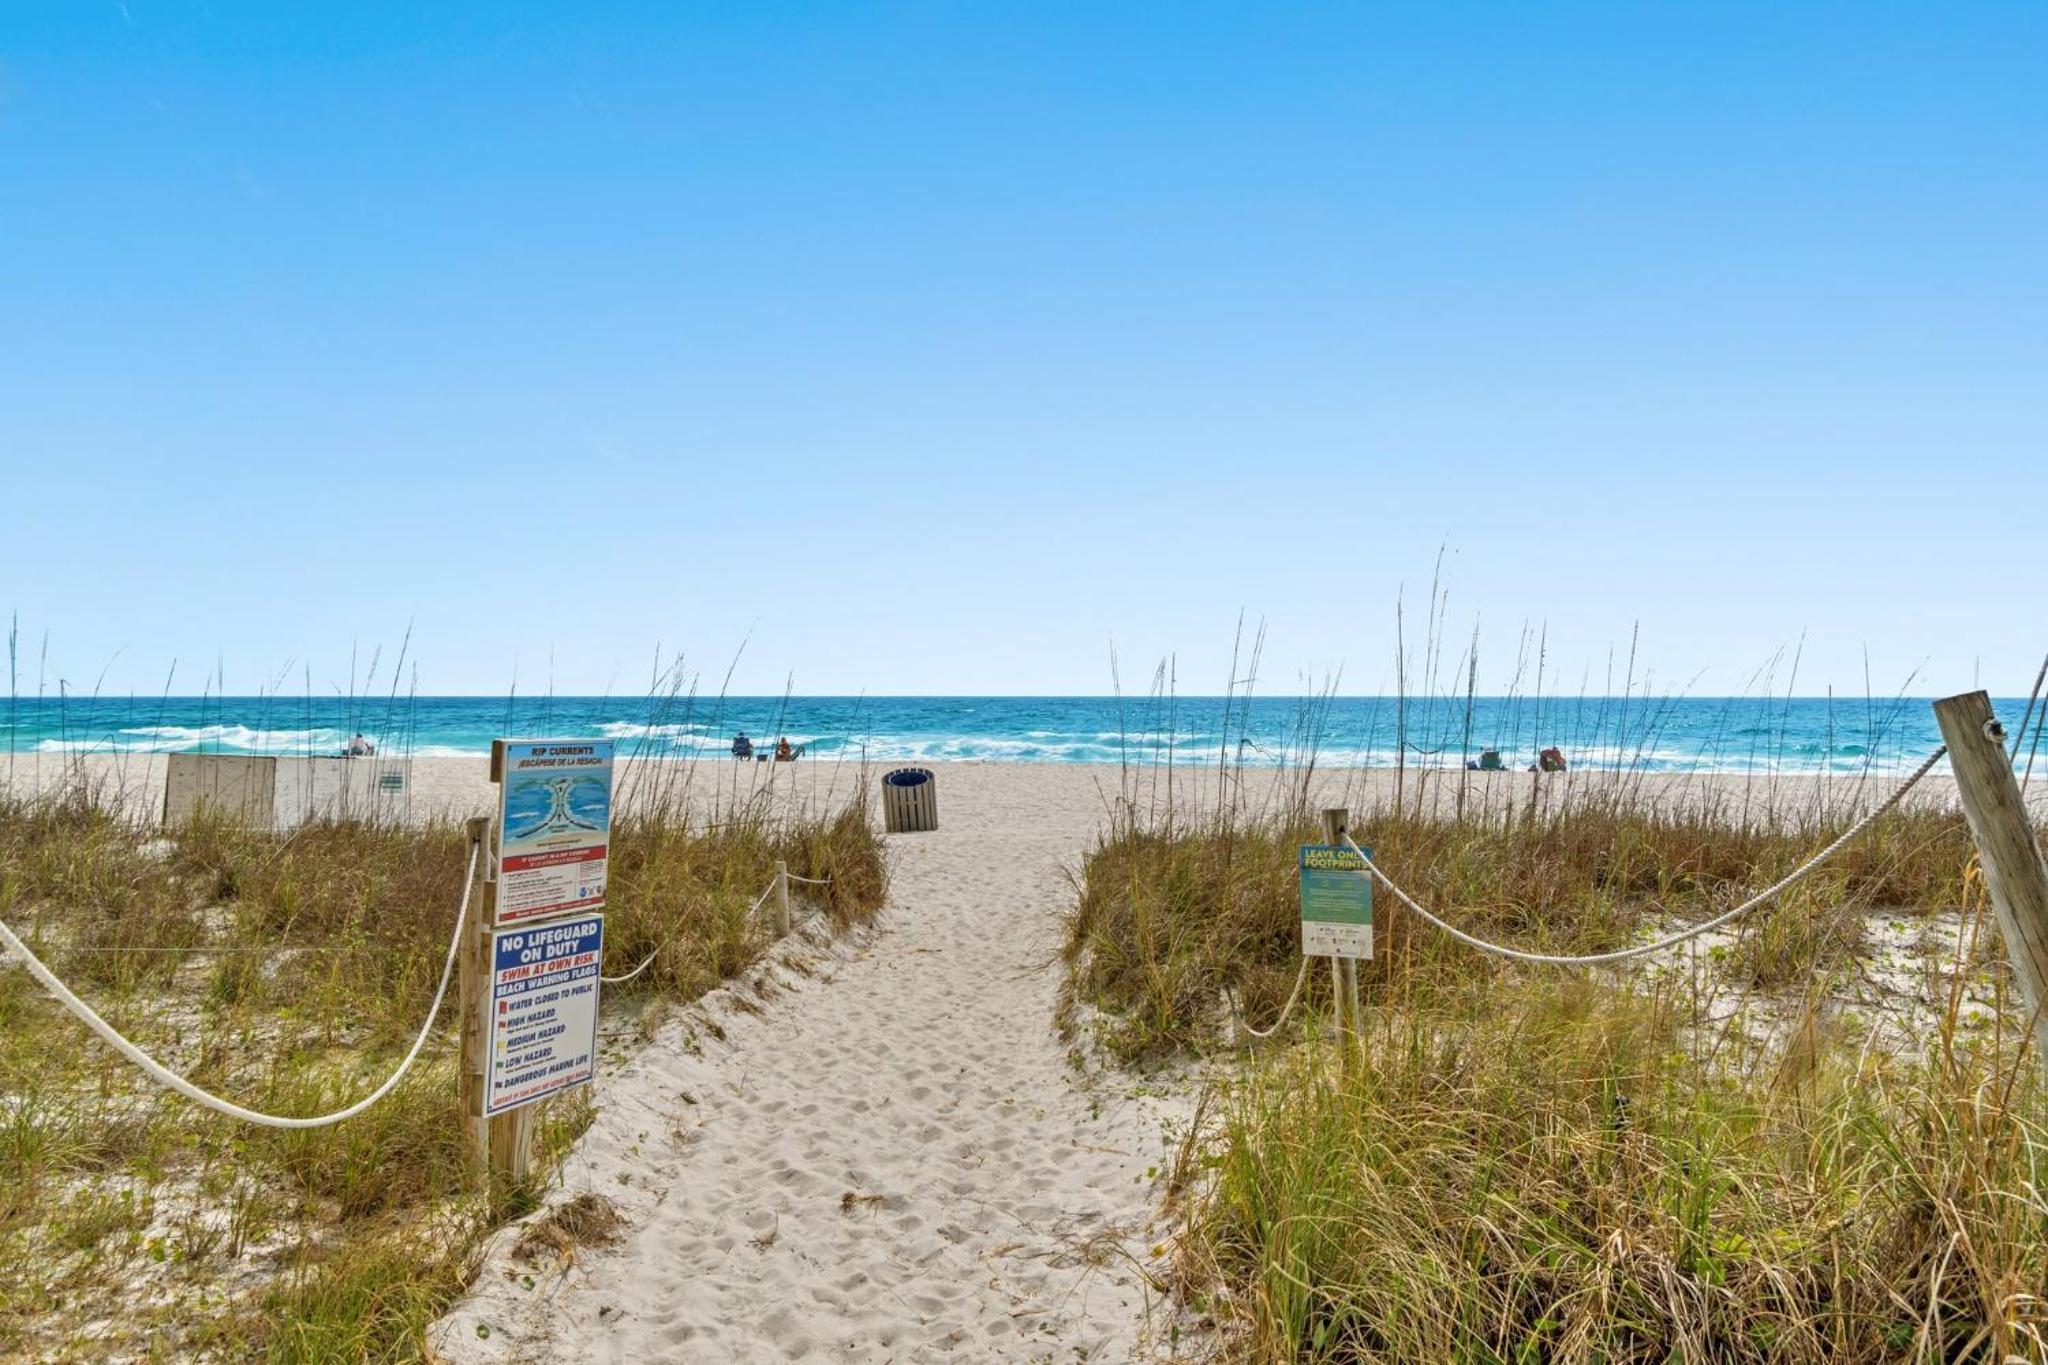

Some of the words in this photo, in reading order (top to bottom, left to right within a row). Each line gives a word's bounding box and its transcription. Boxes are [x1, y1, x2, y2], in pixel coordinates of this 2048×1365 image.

[532, 747, 547, 756] RIP
[549, 746, 594, 756] CURRENTS
[1305, 850, 1333, 858] LEAVE
[1338, 850, 1366, 860] ONL
[502, 936, 524, 952] NO
[528, 922, 598, 947] LIFEGUARD
[521, 947, 542, 963] ON
[546, 940, 579, 958] DUTY
[502, 967, 530, 982] SWIM
[534, 963, 546, 974] AT
[548, 958, 572, 971] OWN
[574, 953, 594, 966] RISK
[496, 982, 525, 997] BEACH
[528, 972, 569, 989] WARNING
[572, 965, 596, 980] FLAGS
[508, 999, 533, 1012] WATER
[534, 992, 560, 1005] CLOSED
[562, 989, 570, 999] TO
[571, 984, 593, 996] PUBLIC
[508, 1016, 526, 1028] HIGH
[527, 1008, 556, 1023] HAZARD
[507, 1032, 536, 1048] MEDIUM
[538, 1024, 566, 1039] HAZARD
[505, 1056, 522, 1068] LOW
[524, 1047, 552, 1062] HAZARD
[504, 1067, 547, 1088] DANGEROUS
[548, 1058, 574, 1074] MARINE
[576, 1054, 588, 1066] LIFE
